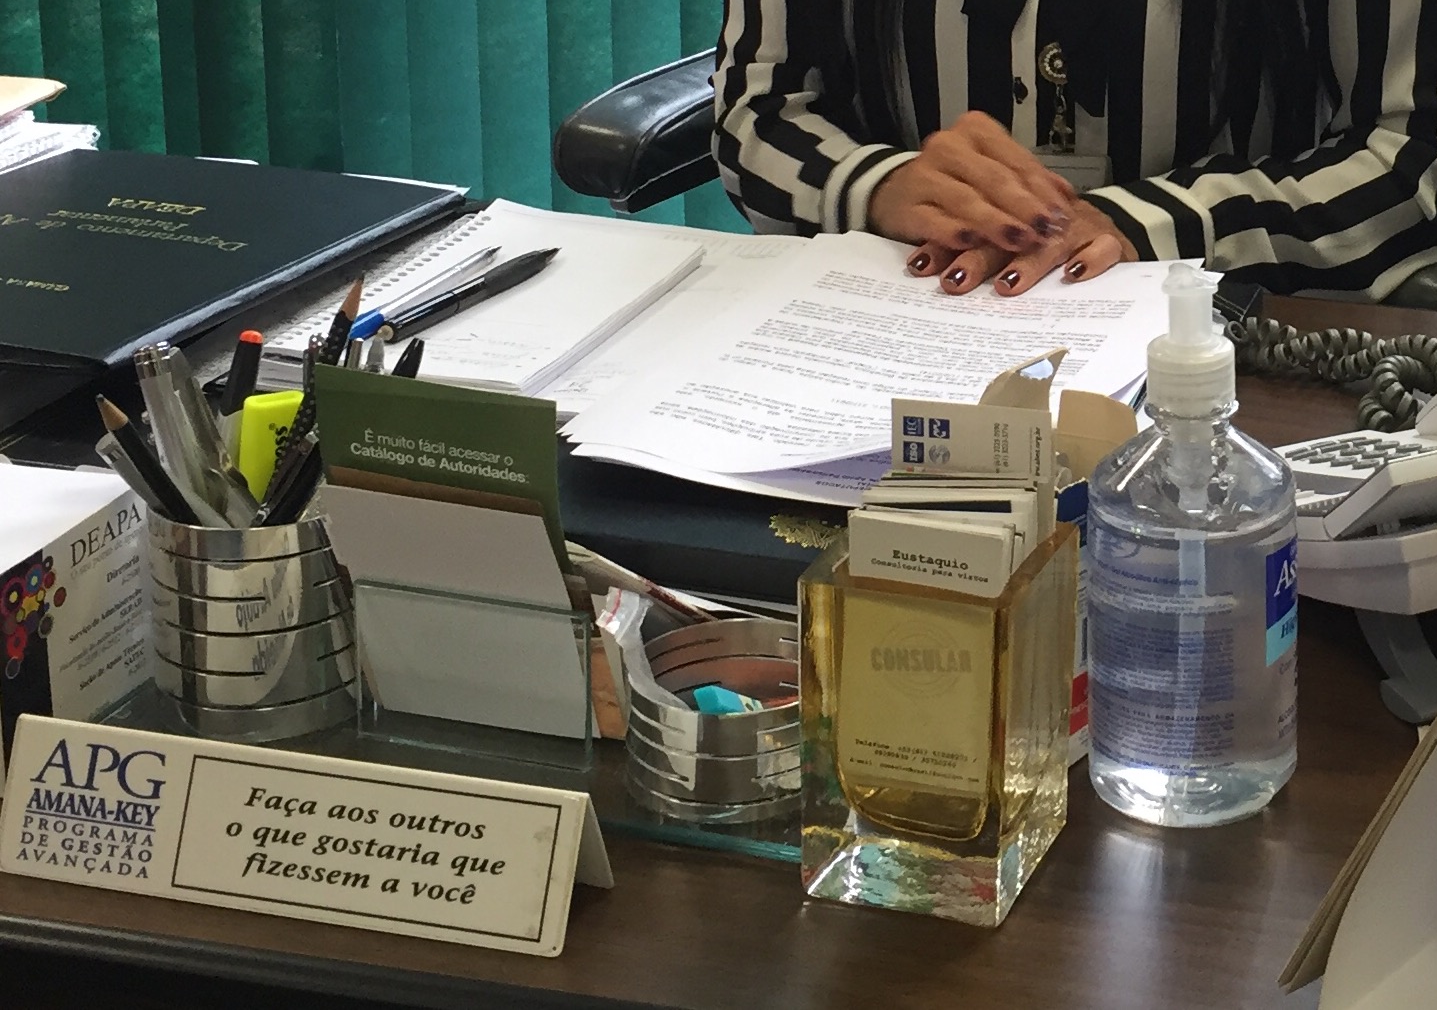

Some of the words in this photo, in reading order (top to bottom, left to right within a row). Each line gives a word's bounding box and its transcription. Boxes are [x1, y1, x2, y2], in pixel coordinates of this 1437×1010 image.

[350, 442, 415, 465] Catálogo
[418, 455, 436, 468] de
[364, 427, 374, 443] É
[377, 435, 416, 450] muito
[418, 438, 445, 455] fácil
[448, 446, 501, 464] acessar
[504, 456, 514, 467] o
[70, 502, 142, 568] DEAPA
[870, 557, 927, 573] Consultoria
[931, 568, 953, 576] para
[892, 549, 969, 570] Eustaquio
[870, 647, 972, 672] CONSULAR
[30, 738, 166, 799] APG
[27, 788, 160, 827] AMANA-KEY
[244, 787, 317, 817] Faça
[327, 803, 379, 824] aos
[389, 811, 487, 839] outros
[20, 832, 49, 847] DE
[61, 837, 153, 863] GESTÃO
[22, 815, 154, 847] PROGRAMA
[226, 821, 243, 837] o
[252, 826, 307, 847] que
[312, 834, 440, 866] gostaria
[450, 854, 506, 876] que
[16, 847, 149, 879] AVANÇADA
[242, 852, 370, 889] fizessem
[381, 877, 401, 894] a
[411, 880, 477, 905] você
